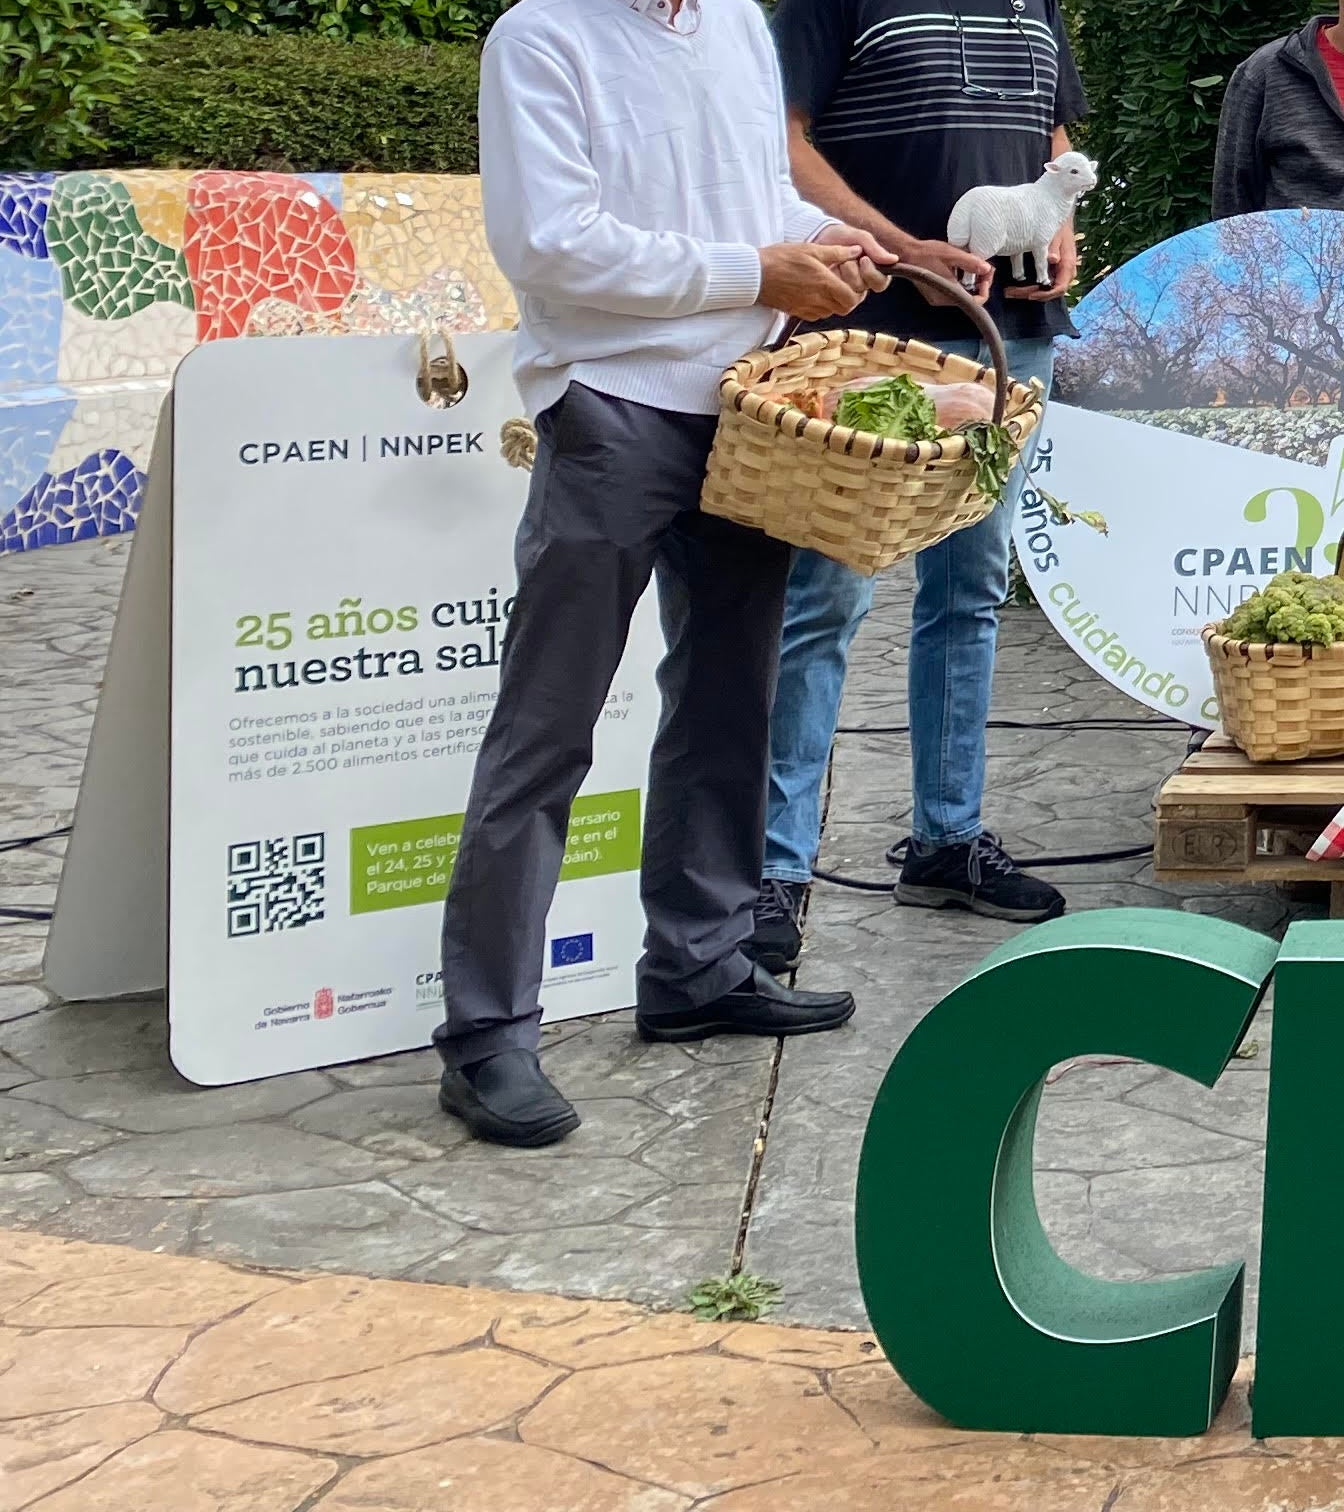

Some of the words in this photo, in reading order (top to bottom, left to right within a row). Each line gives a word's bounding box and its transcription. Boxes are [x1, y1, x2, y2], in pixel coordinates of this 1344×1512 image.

[238, 438, 349, 465] CPAEN
[380, 432, 484, 458] NNPEK
[1173, 546, 1314, 577] CPAEN
[1173, 584, 1260, 616] NNP
[235, 612, 293, 651] 25
[306, 597, 419, 640] años
[234, 646, 424, 693] nuestra
[435, 626, 502, 671] sal
[1048, 582, 1190, 708] cuidando
[229, 711, 318, 731] Ofrecemos
[322, 711, 331, 720] a
[337, 706, 349, 718] la
[355, 698, 424, 717] sociedad
[428, 696, 455, 709] una
[460, 691, 499, 705] alime
[622, 691, 633, 702] la
[320, 719, 390, 738] sabiendo
[395, 716, 424, 729] que
[428, 714, 445, 725] es
[449, 710, 462, 721] la
[466, 708, 491, 722] agr
[604, 707, 629, 721] hay
[229, 751, 259, 766] que
[264, 746, 308, 761] cuida
[312, 742, 326, 755] al
[331, 735, 389, 755] planeta
[393, 735, 402, 748] y
[407, 733, 416, 744] a
[421, 729, 441, 742] las
[446, 725, 487, 741] perso
[229, 767, 262, 782] más
[266, 764, 287, 778] de
[292, 757, 338, 775] 2.500
[343, 750, 418, 769] alimentos
[422, 741, 482, 758] certifica
[366, 842, 398, 857] Ven
[402, 840, 411, 852] a
[416, 832, 461, 850] celebr
[366, 861, 380, 876] el
[384, 858, 409, 874] 24,
[413, 854, 433, 869] 25
[436, 854, 445, 868] y
[449, 849, 459, 864] 2
[583, 832, 601, 843] en
[604, 826, 617, 840] el
[366, 876, 422, 896] Parque
[426, 872, 446, 886] de
[562, 847, 602, 865] oáin).
[416, 970, 444, 986] CPA
[263, 1002, 310, 1017] Gobierno
[270, 1013, 311, 1028] Navarra
